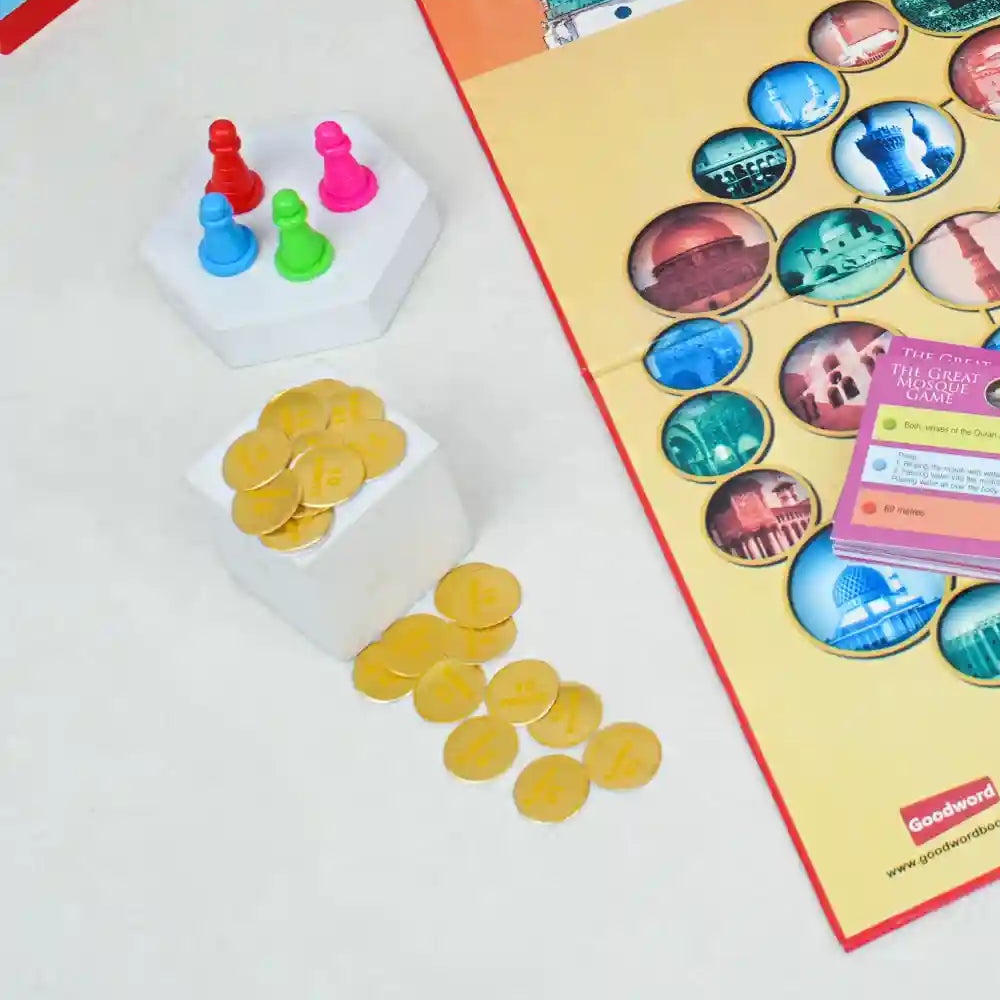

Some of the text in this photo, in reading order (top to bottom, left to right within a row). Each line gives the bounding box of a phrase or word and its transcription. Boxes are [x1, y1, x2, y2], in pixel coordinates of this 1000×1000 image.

[891, 363, 981, 383] THE GREAT
[896, 374, 969, 394] MOSQUE
[905, 388, 953, 404] GAME
[908, 782, 997, 833] Goodword
